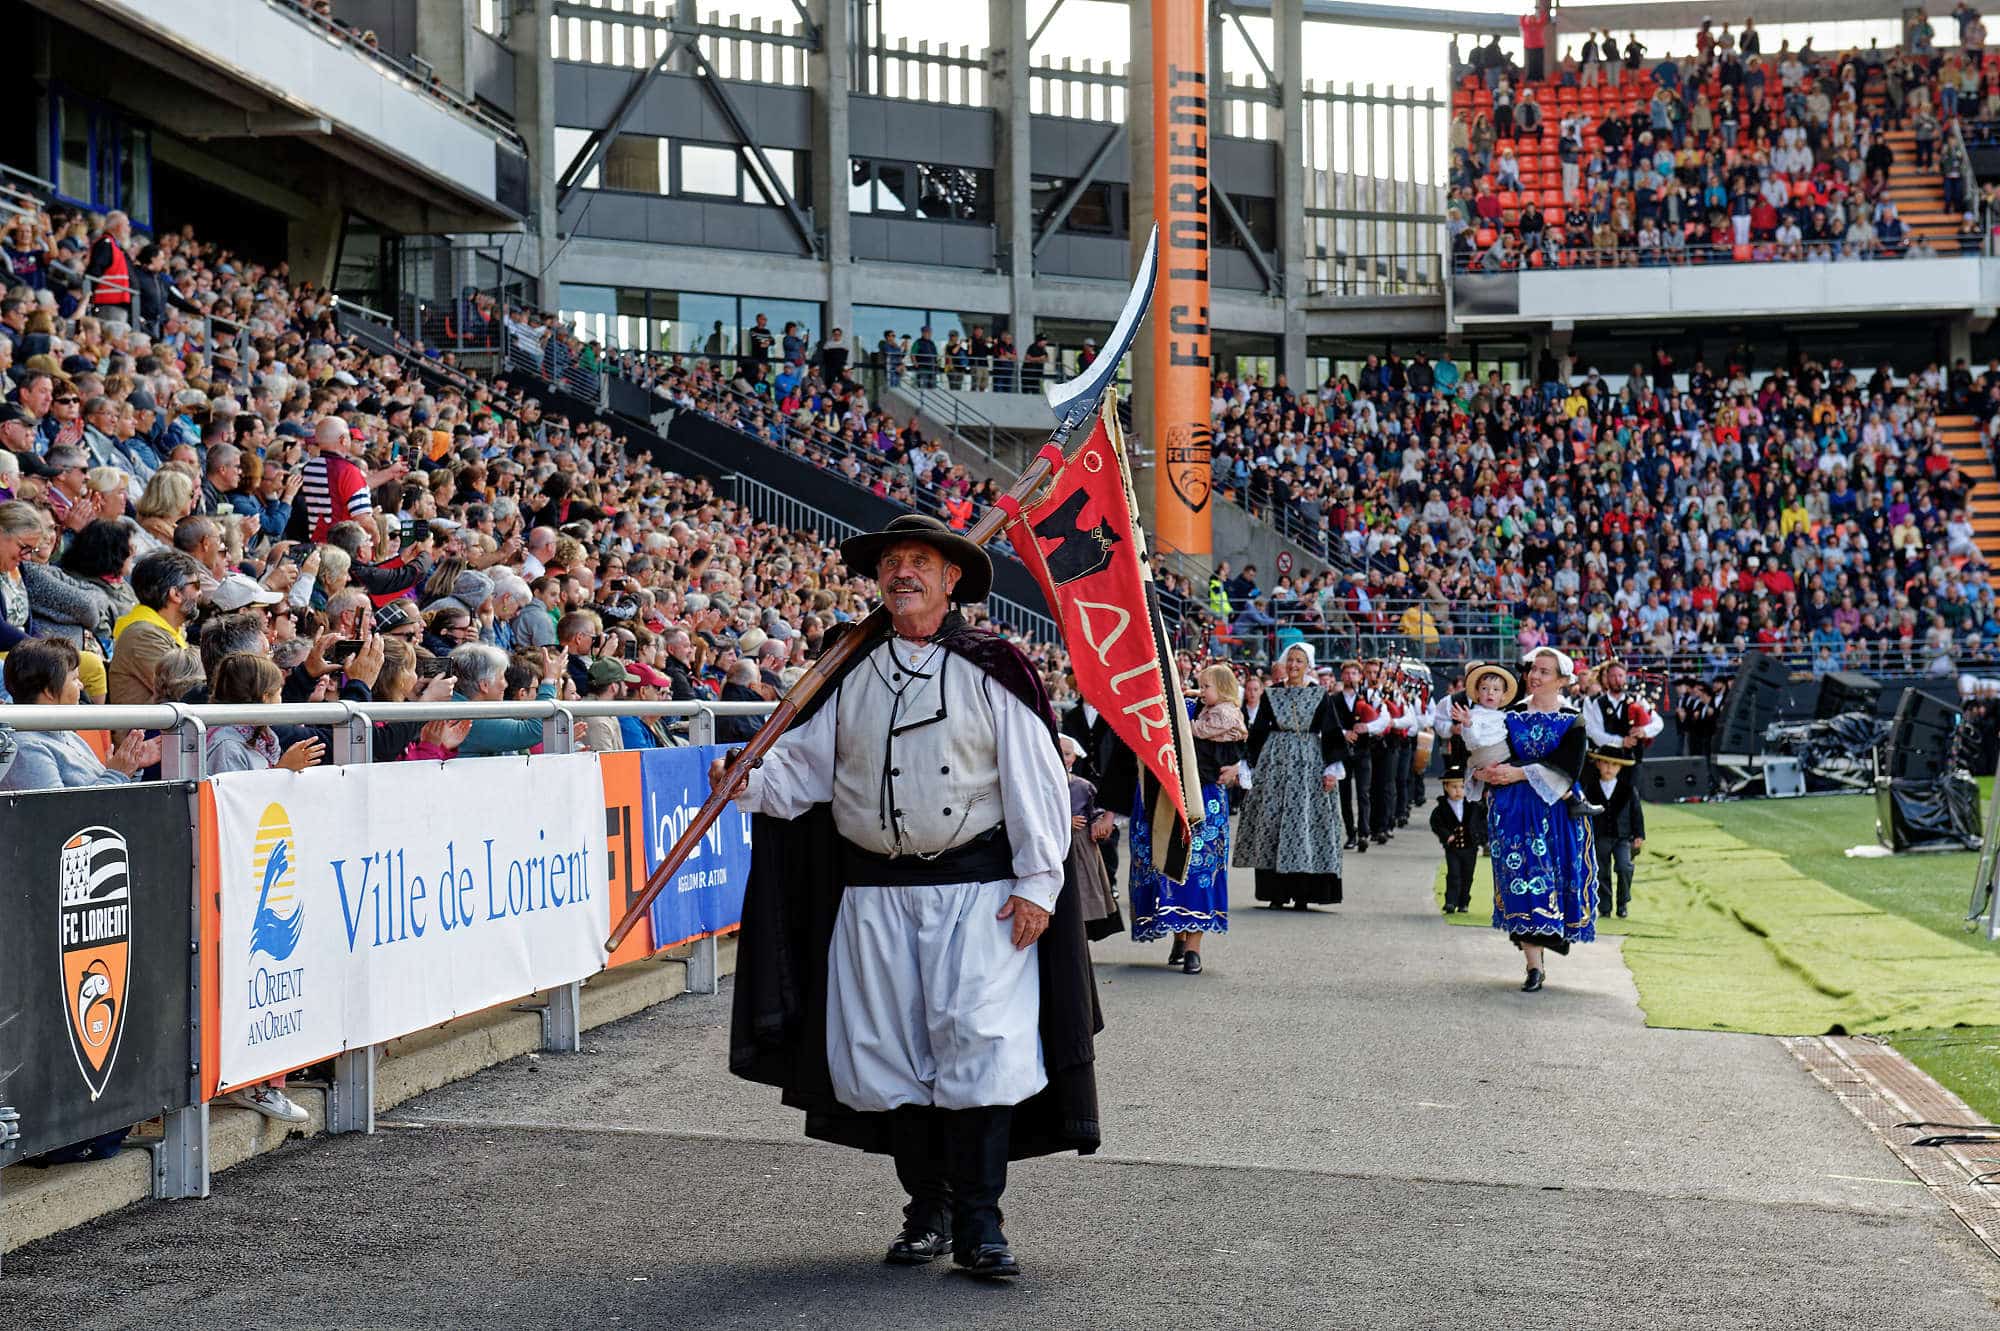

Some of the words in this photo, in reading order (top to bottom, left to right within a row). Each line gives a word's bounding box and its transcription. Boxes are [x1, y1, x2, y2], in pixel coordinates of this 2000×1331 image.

[1169, 63, 1208, 282] LORIENT
[1170, 305, 1209, 368] FC
[330, 847, 427, 954] Ville
[439, 840, 475, 931] de
[482, 829, 592, 922] Lorient
[63, 912, 79, 946] FC
[82, 904, 128, 942] LORIENT
[248, 967, 304, 1010] LORIENT
